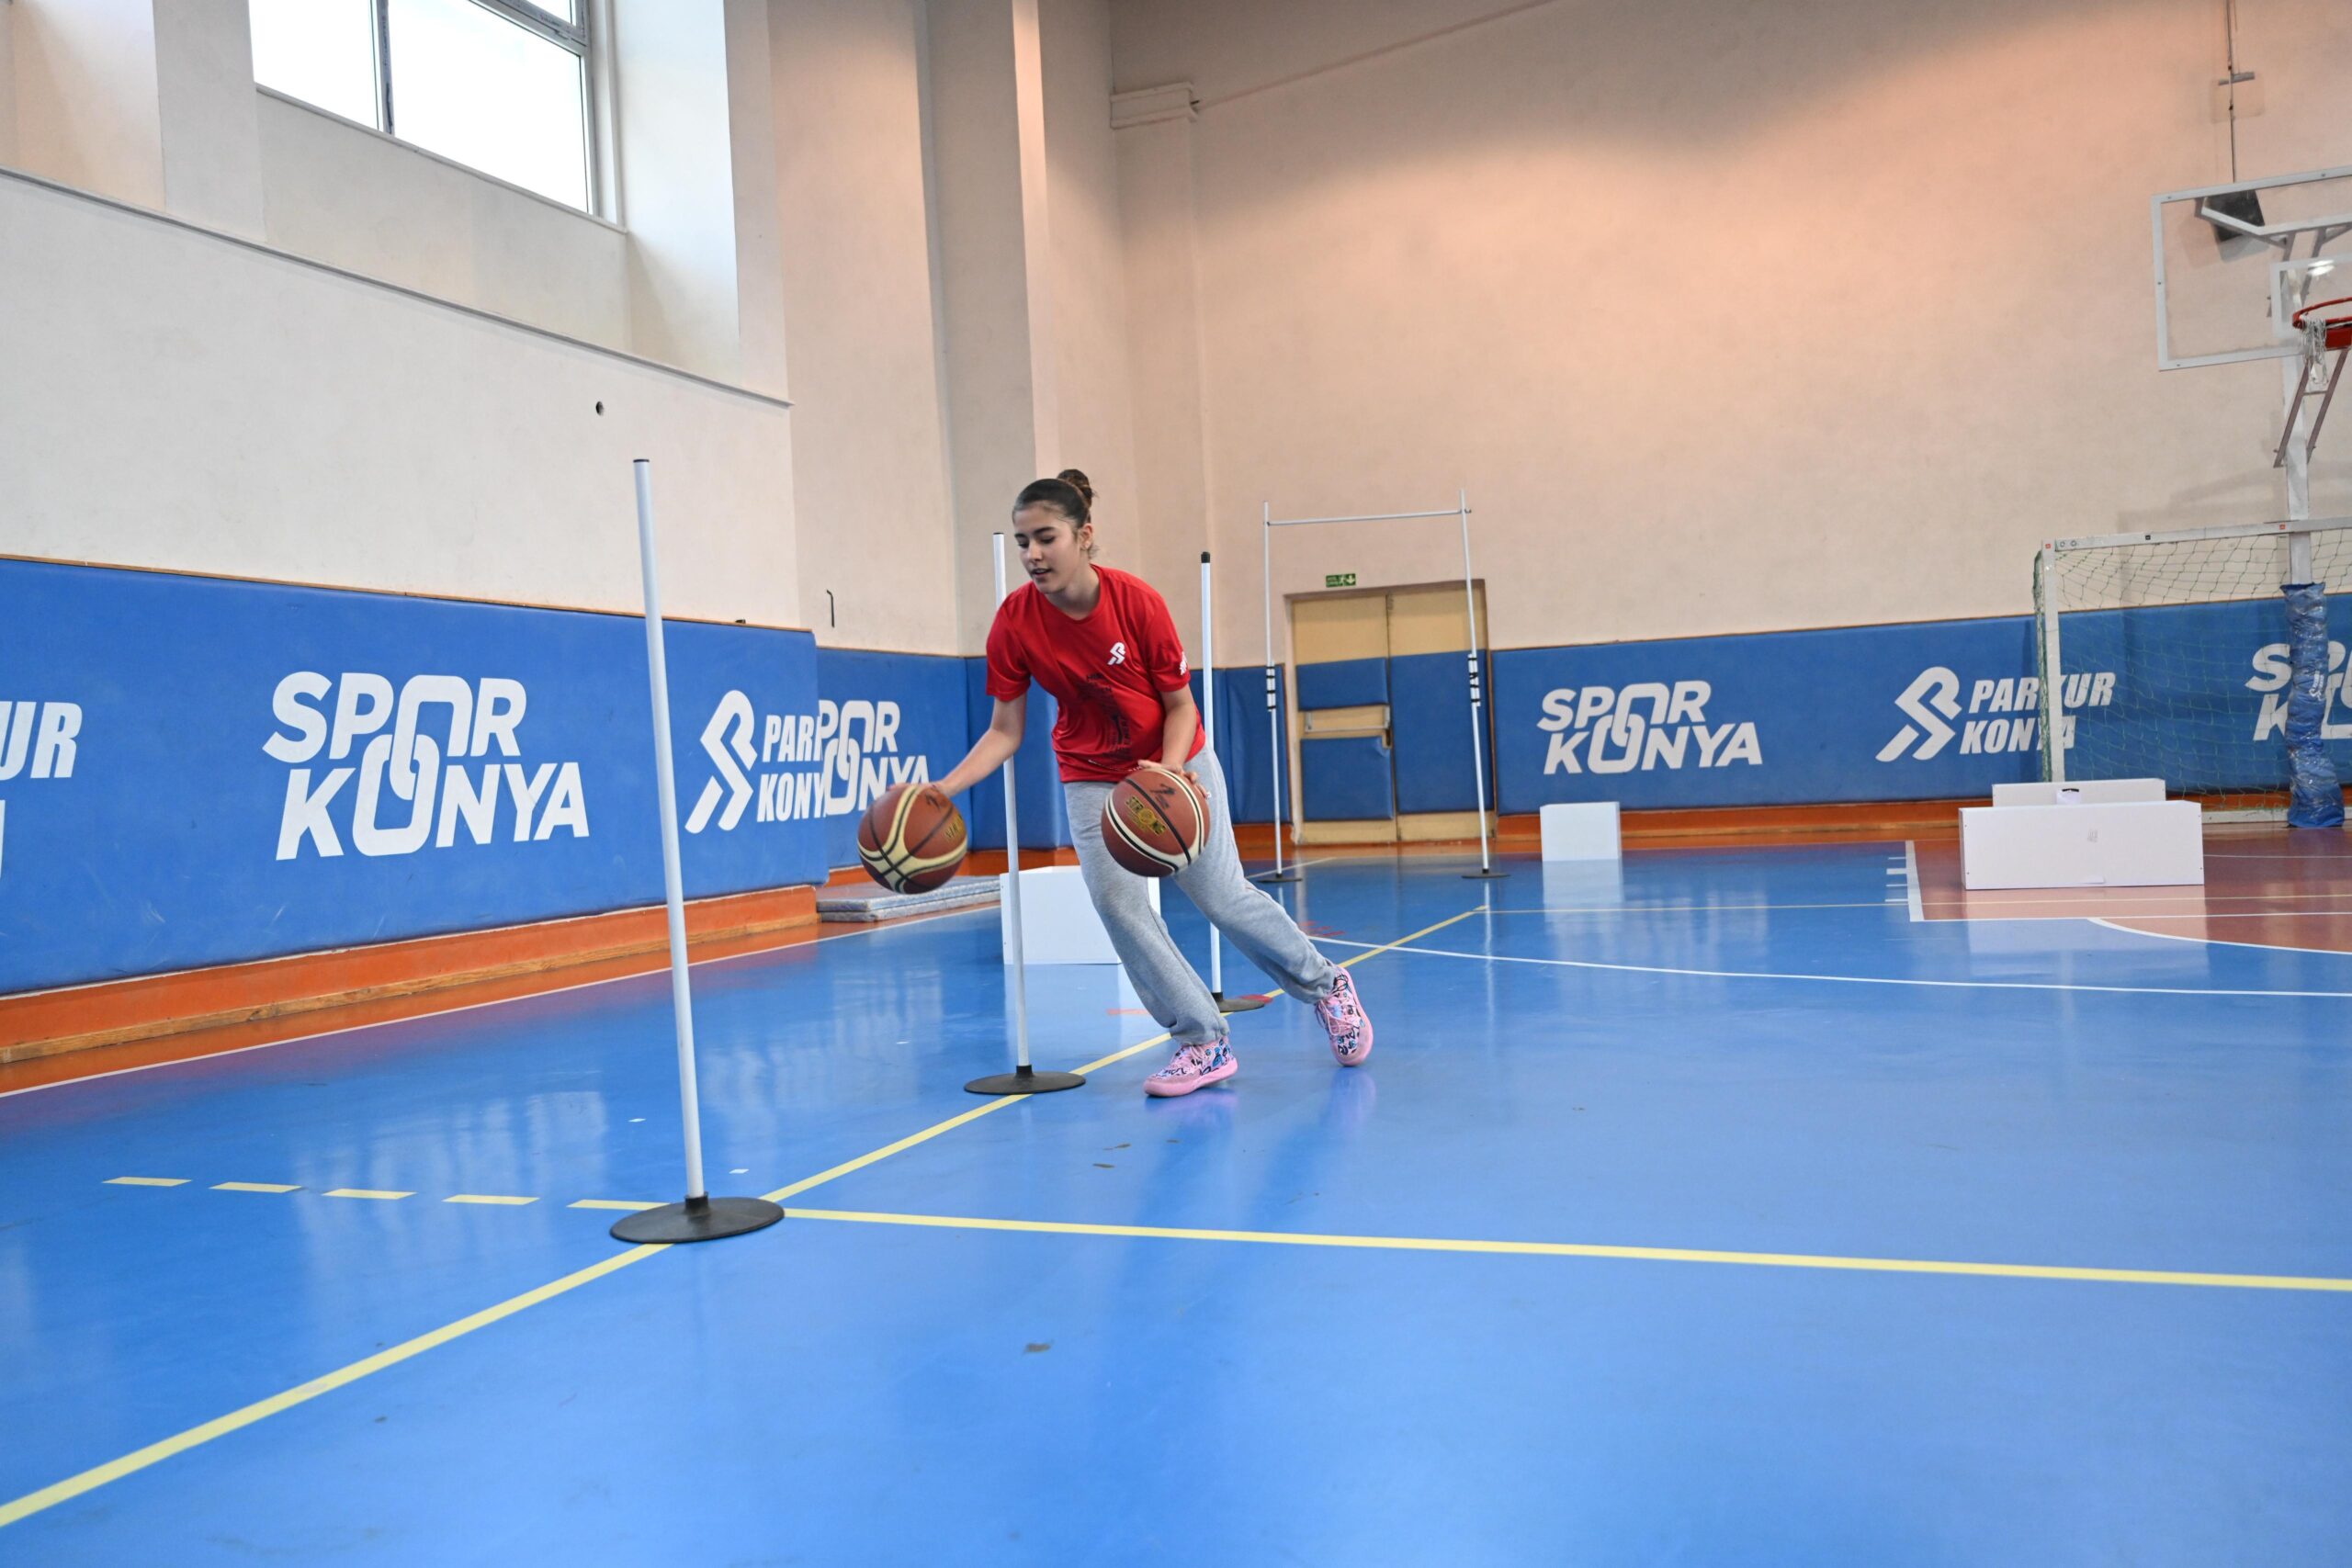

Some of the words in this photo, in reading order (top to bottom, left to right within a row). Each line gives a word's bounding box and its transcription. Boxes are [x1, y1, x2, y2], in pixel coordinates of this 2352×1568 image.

[1536, 680, 1712, 747] SPOR
[1968, 671, 2117, 714] PARUR
[262, 671, 527, 800] SPOR
[1544, 714, 1763, 775] KONYA
[1959, 715, 2076, 755] KONA
[276, 734, 590, 861] KONYA
[756, 773, 827, 822] KONY
